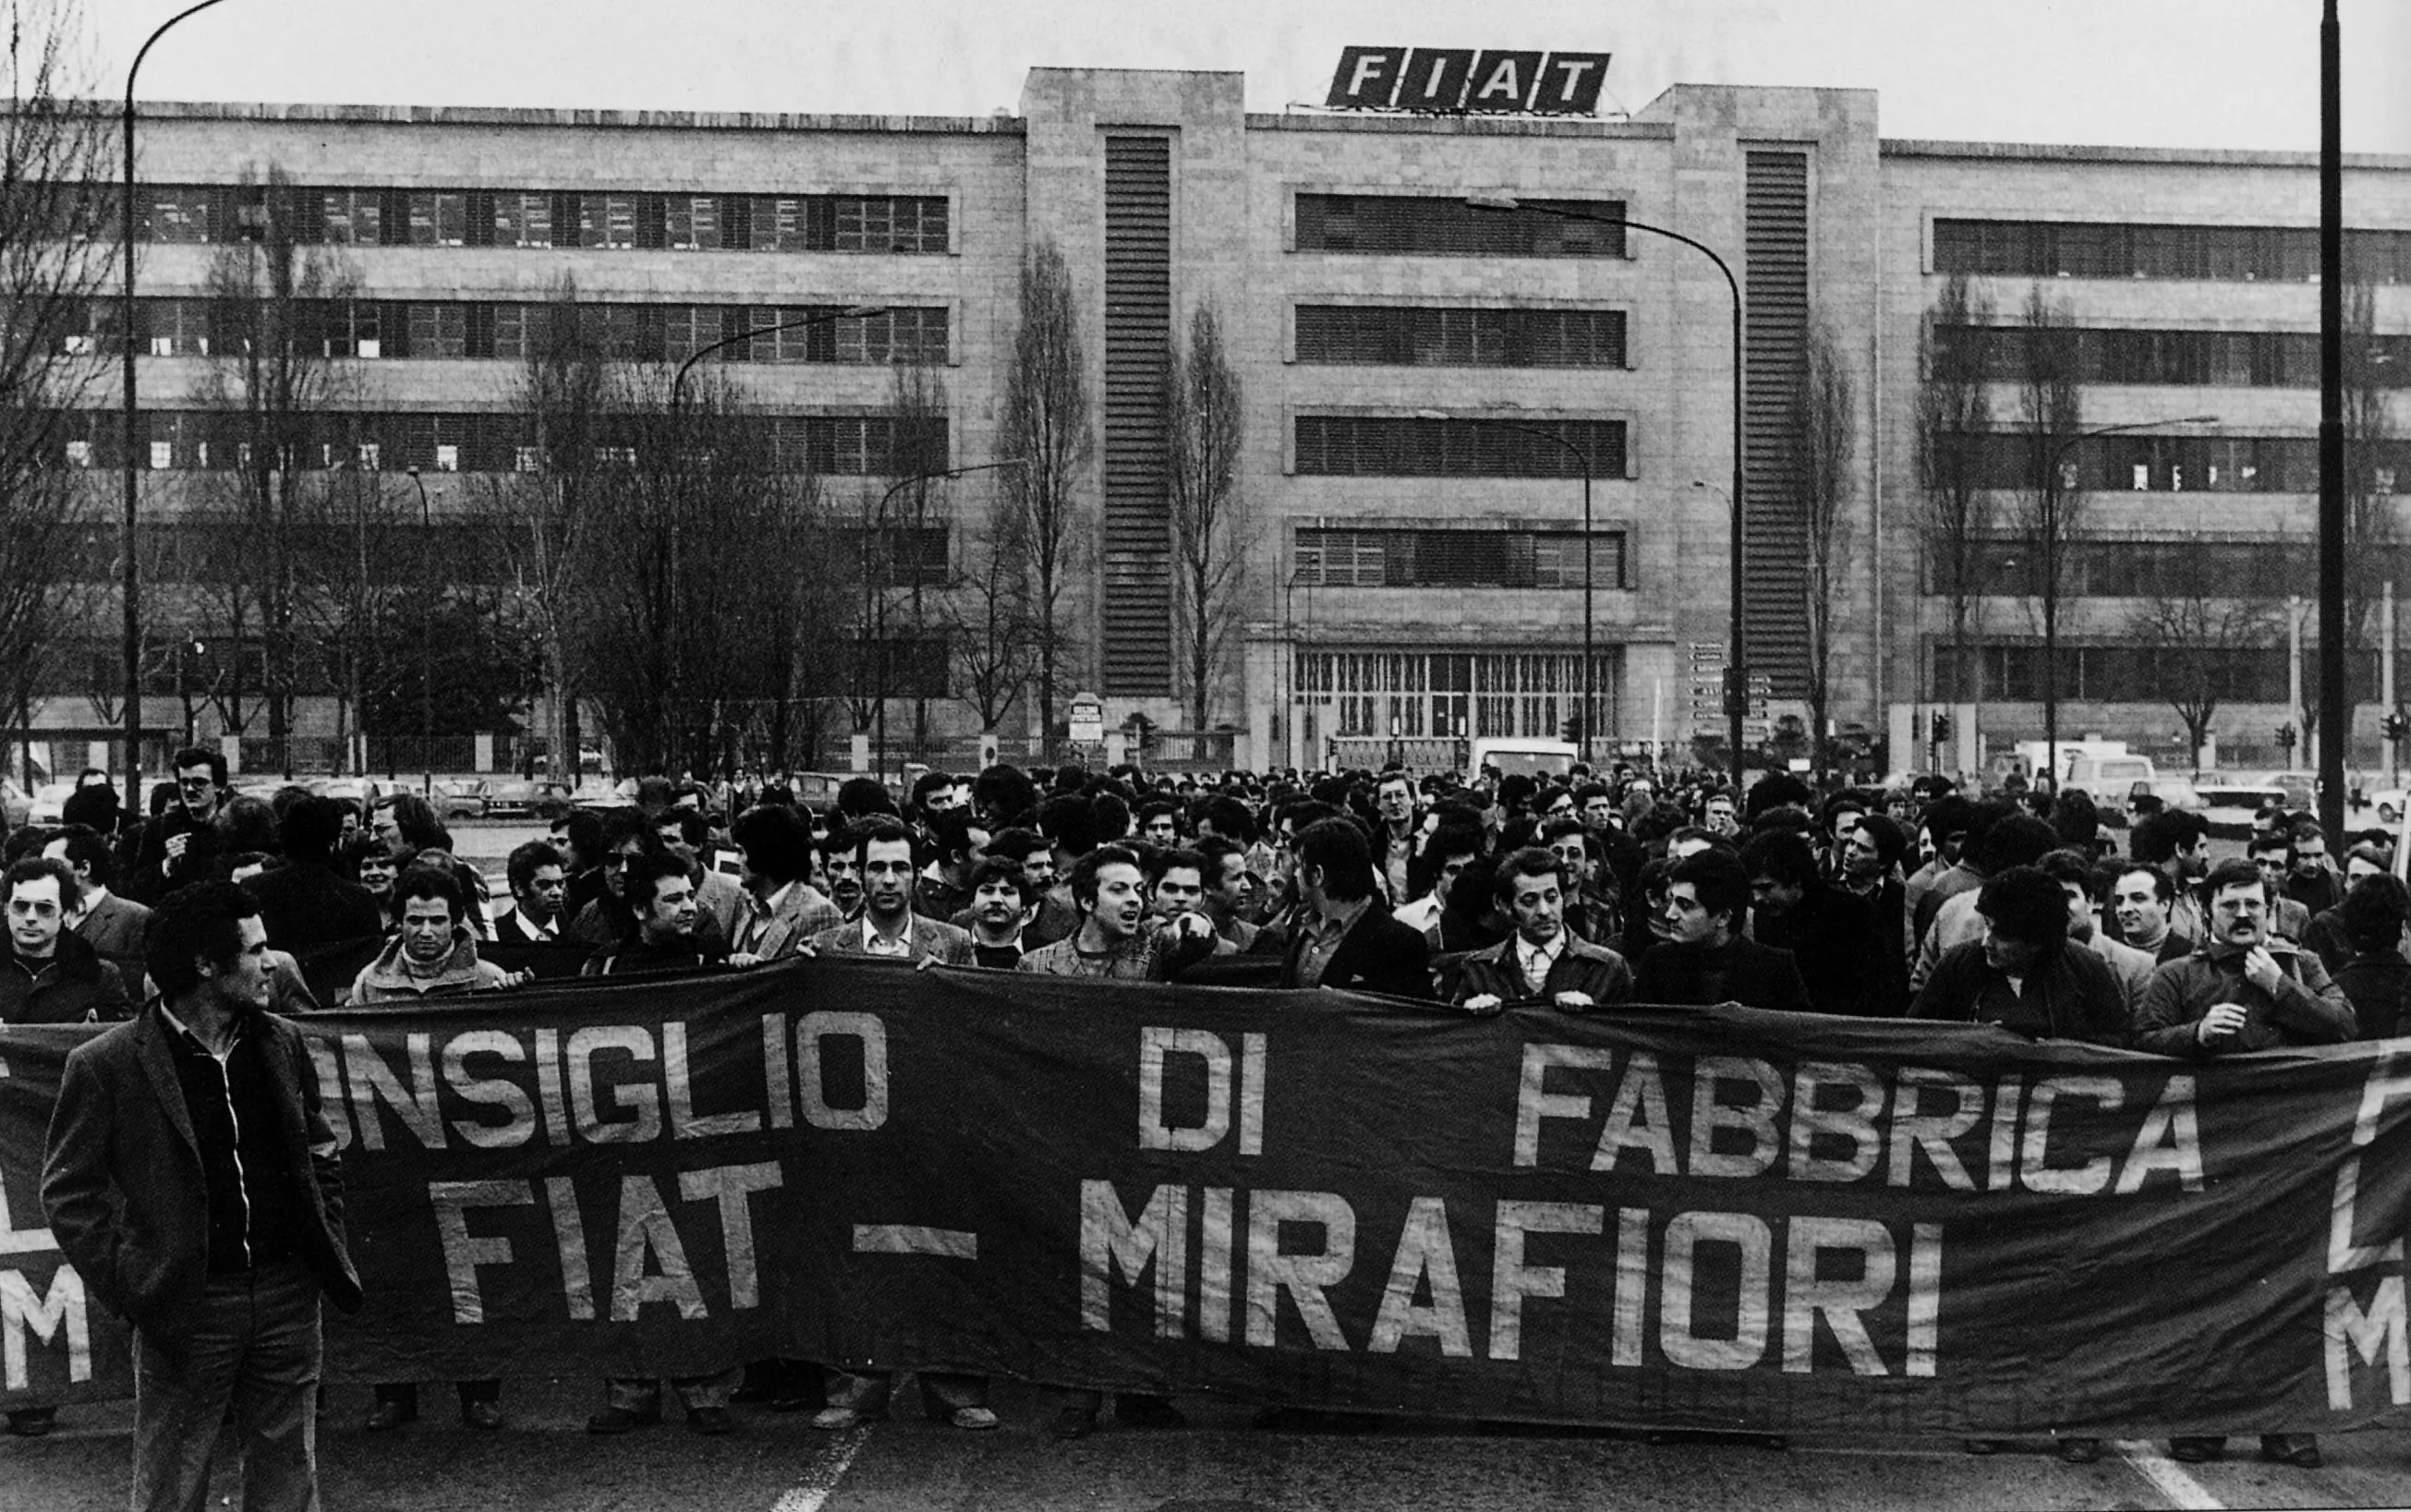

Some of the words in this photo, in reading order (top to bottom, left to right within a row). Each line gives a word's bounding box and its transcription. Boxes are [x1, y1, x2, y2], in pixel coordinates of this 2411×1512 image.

[1347, 55, 1594, 101] FIAT
[1139, 1026, 1266, 1155] DI
[1514, 1044, 2204, 1194] FABBRICA
[429, 1160, 784, 1324] FIAT
[1080, 1179, 1944, 1378] MIRAFIORI
[2327, 1156, 2405, 1274] L
[0, 1264, 92, 1390] M
[2324, 1276, 2411, 1410] M
